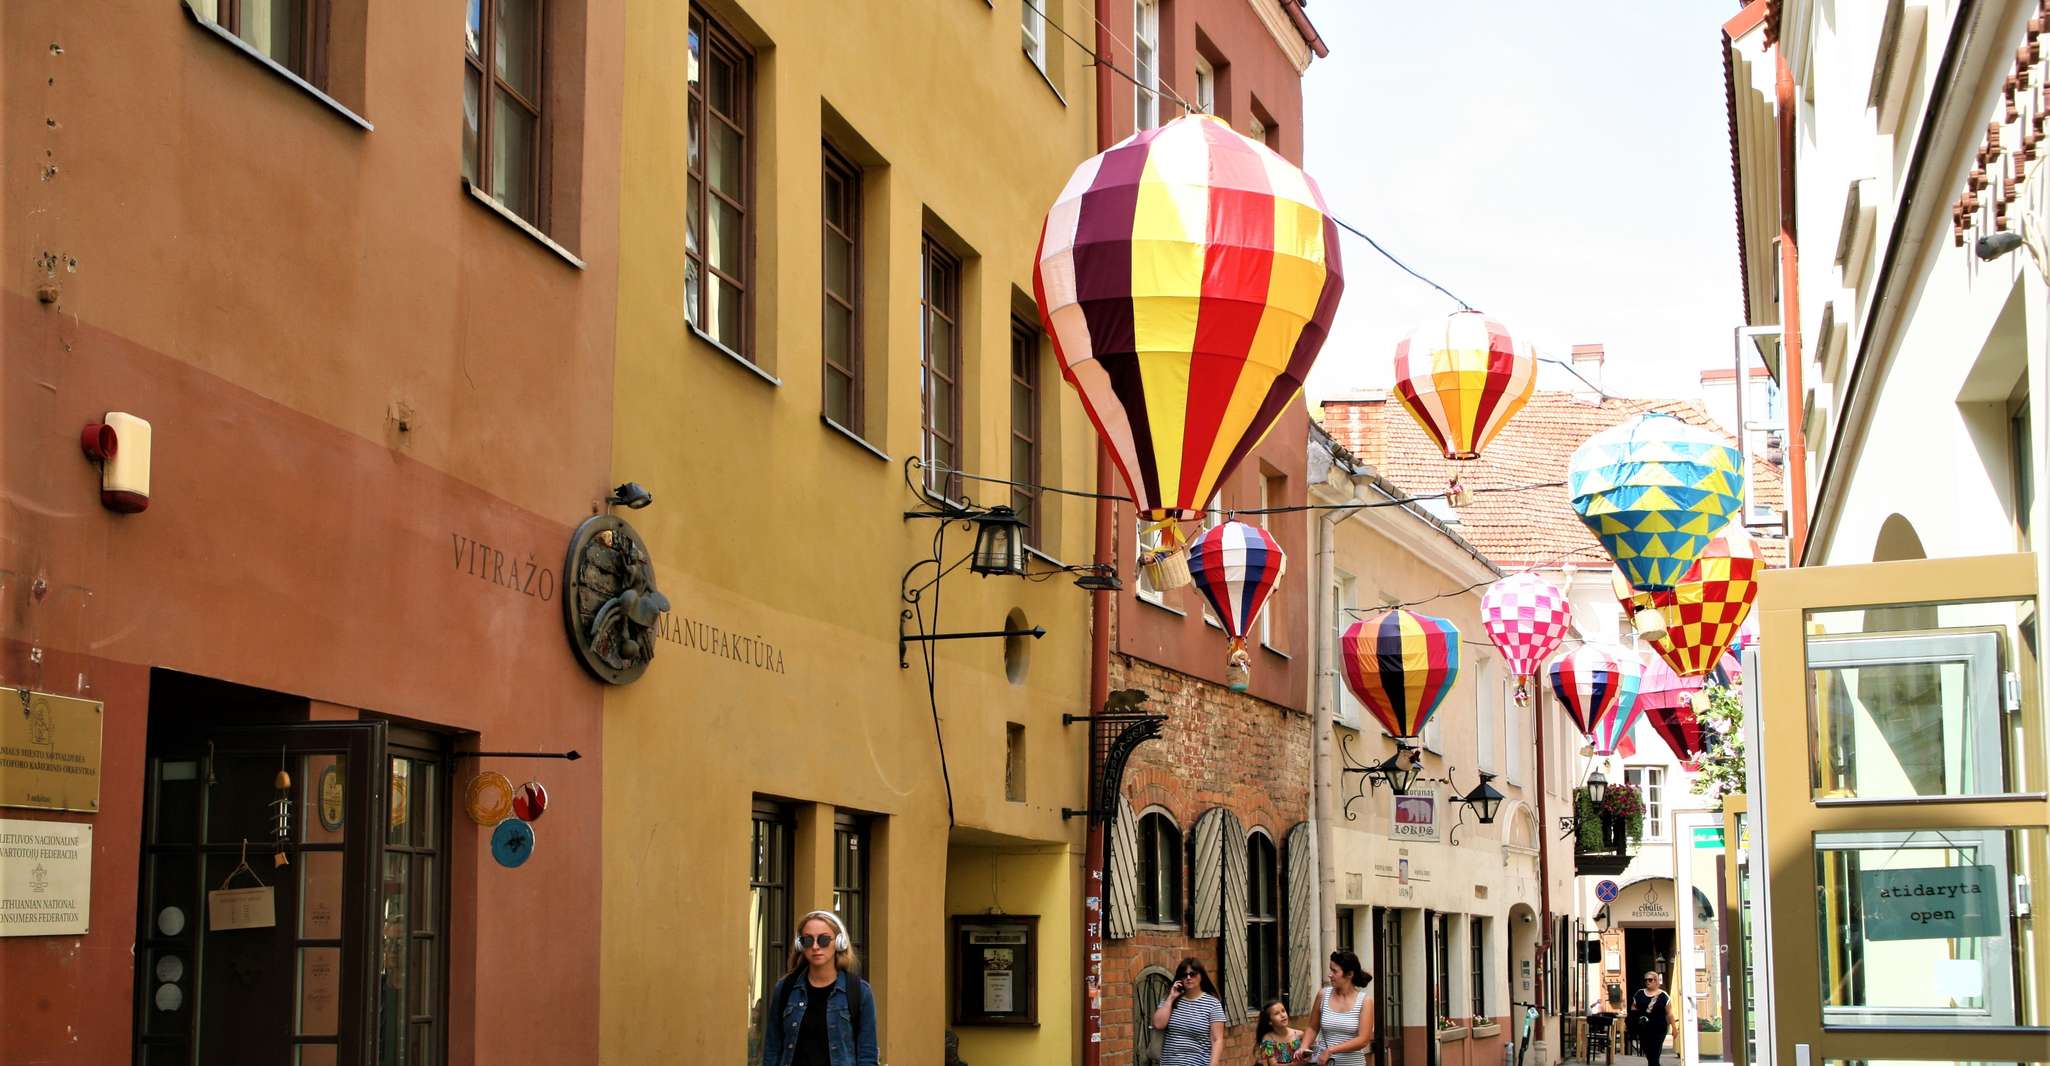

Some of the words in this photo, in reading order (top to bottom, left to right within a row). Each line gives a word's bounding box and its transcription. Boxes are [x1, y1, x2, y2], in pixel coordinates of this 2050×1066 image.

[451, 533, 554, 602] VITRAŽO
[656, 612, 786, 675] MANUFAKTŪRA
[0, 833, 34, 845] LIETUVOS
[34, 835, 79, 847] NACIONALINĖ
[40, 848, 78, 860] FEDERACIJA
[1880, 882, 1982, 899] atidaryta
[43, 899, 76, 910] NATIONAL
[0, 912, 38, 924] ONSUMERS
[38, 912, 79, 923] FEDERATION
[1910, 909, 1956, 924] open
